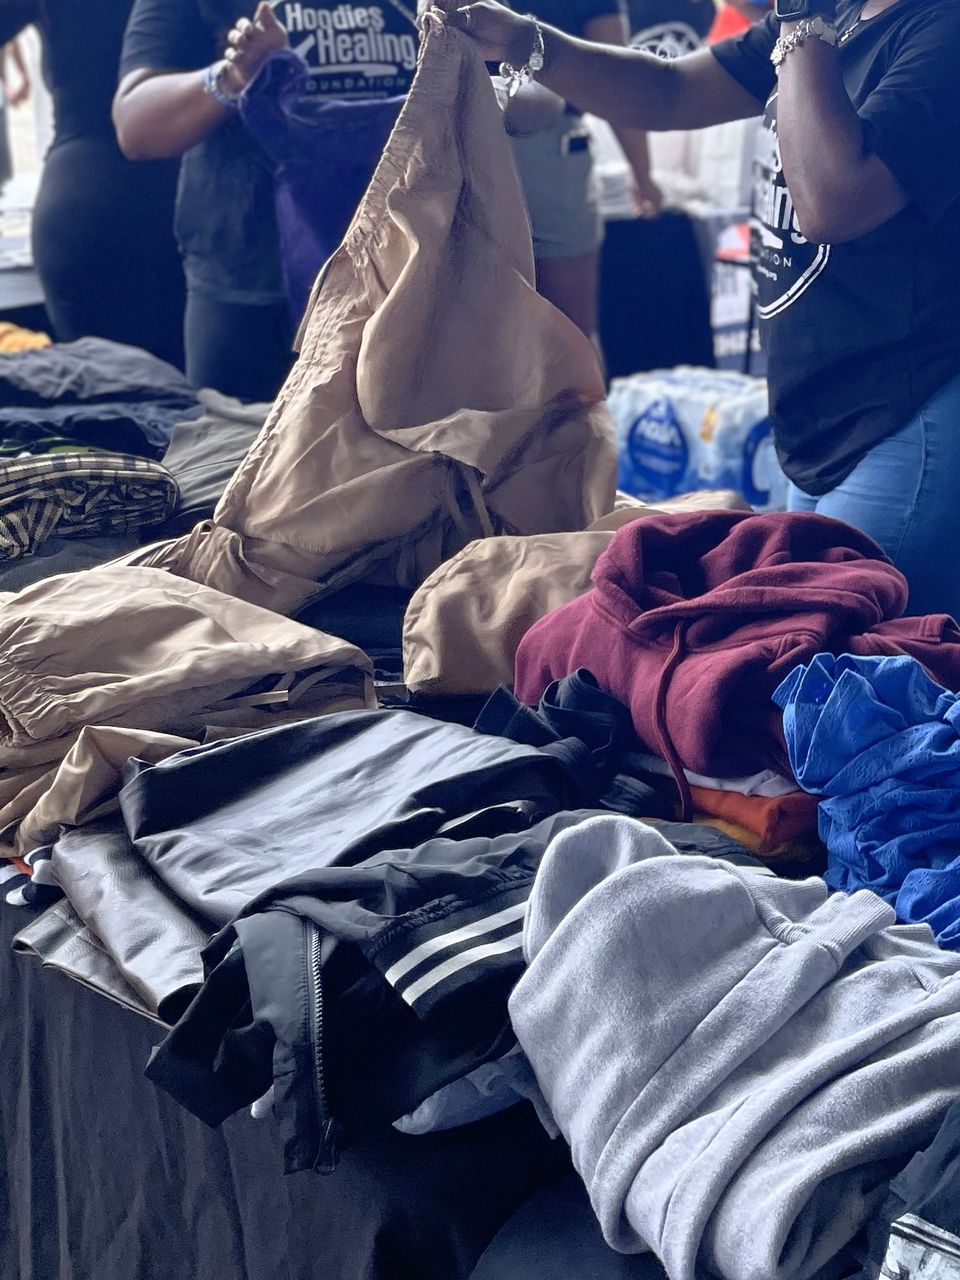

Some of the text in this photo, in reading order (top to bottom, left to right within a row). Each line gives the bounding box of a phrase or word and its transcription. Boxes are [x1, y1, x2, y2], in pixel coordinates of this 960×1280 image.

[284, 3, 385, 32] Hoodies
[316, 28, 417, 70] Healing
[305, 77, 406, 91] OUNDATION
